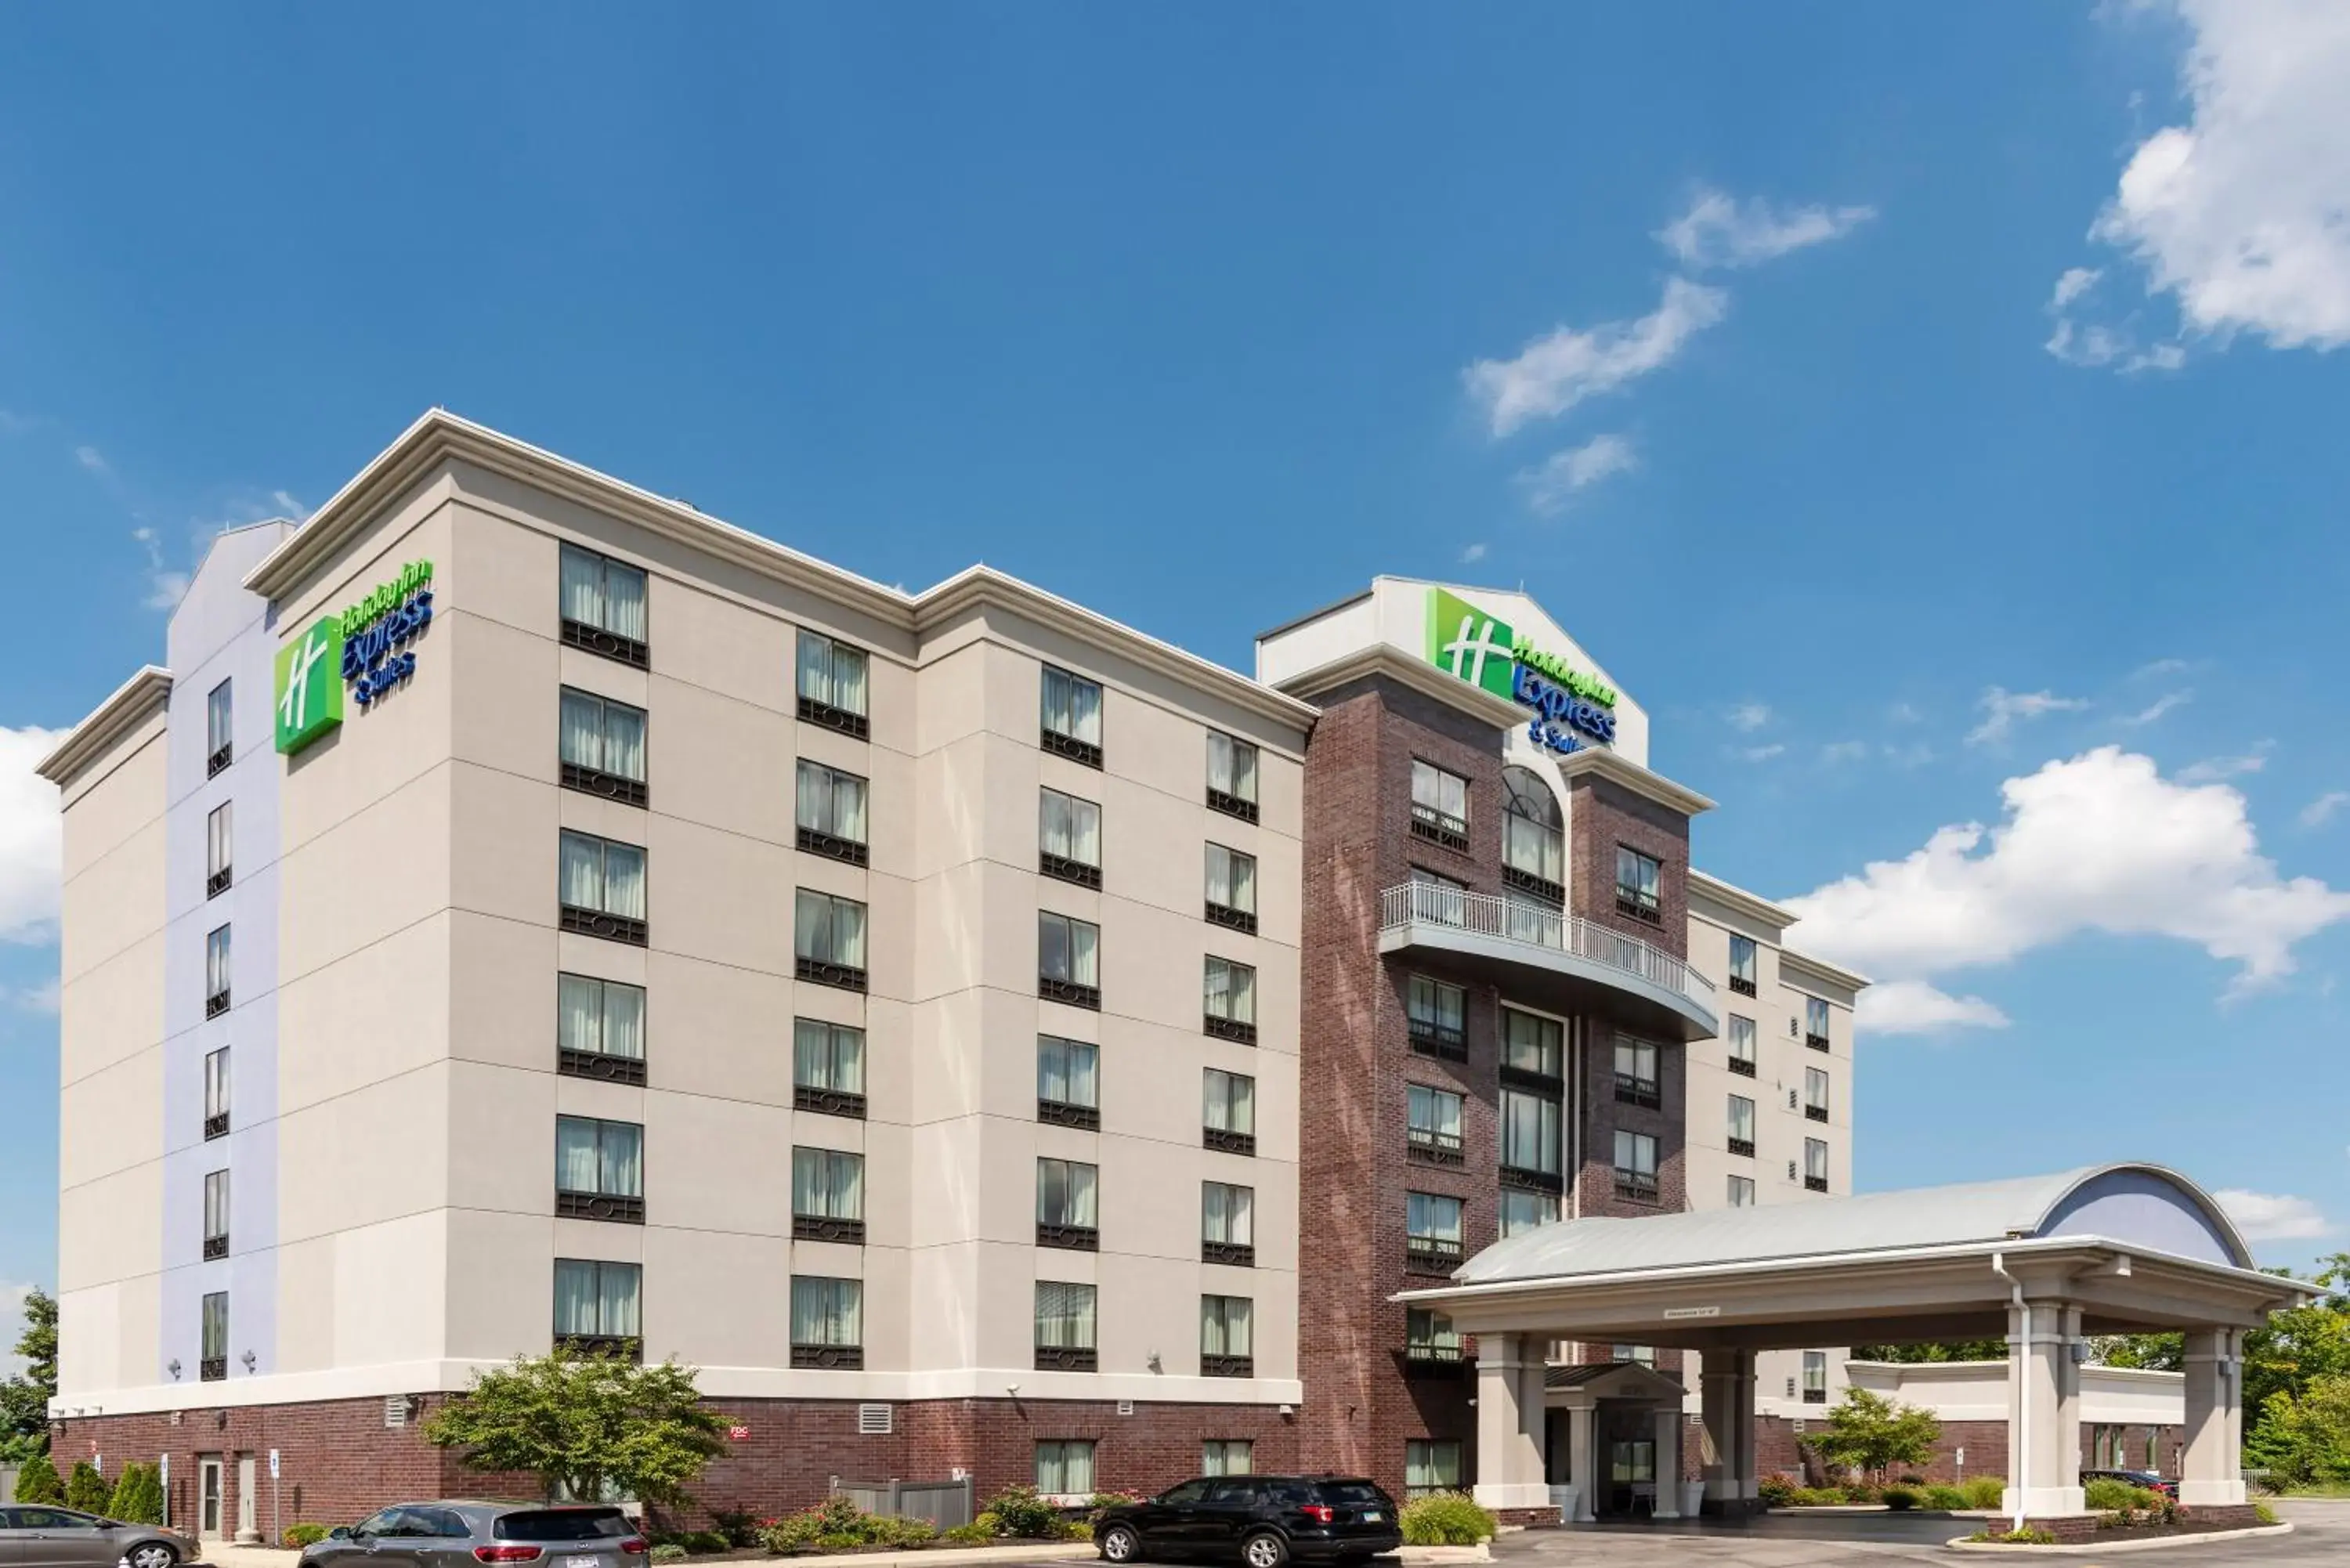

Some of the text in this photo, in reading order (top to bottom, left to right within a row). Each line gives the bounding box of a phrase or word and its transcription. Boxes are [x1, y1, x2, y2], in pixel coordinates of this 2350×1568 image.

[338, 558, 432, 638] Holiday Inn
[341, 590, 433, 680] Express
[1513, 635, 1586, 695] Holiday
[1513, 665, 1616, 742] Express
